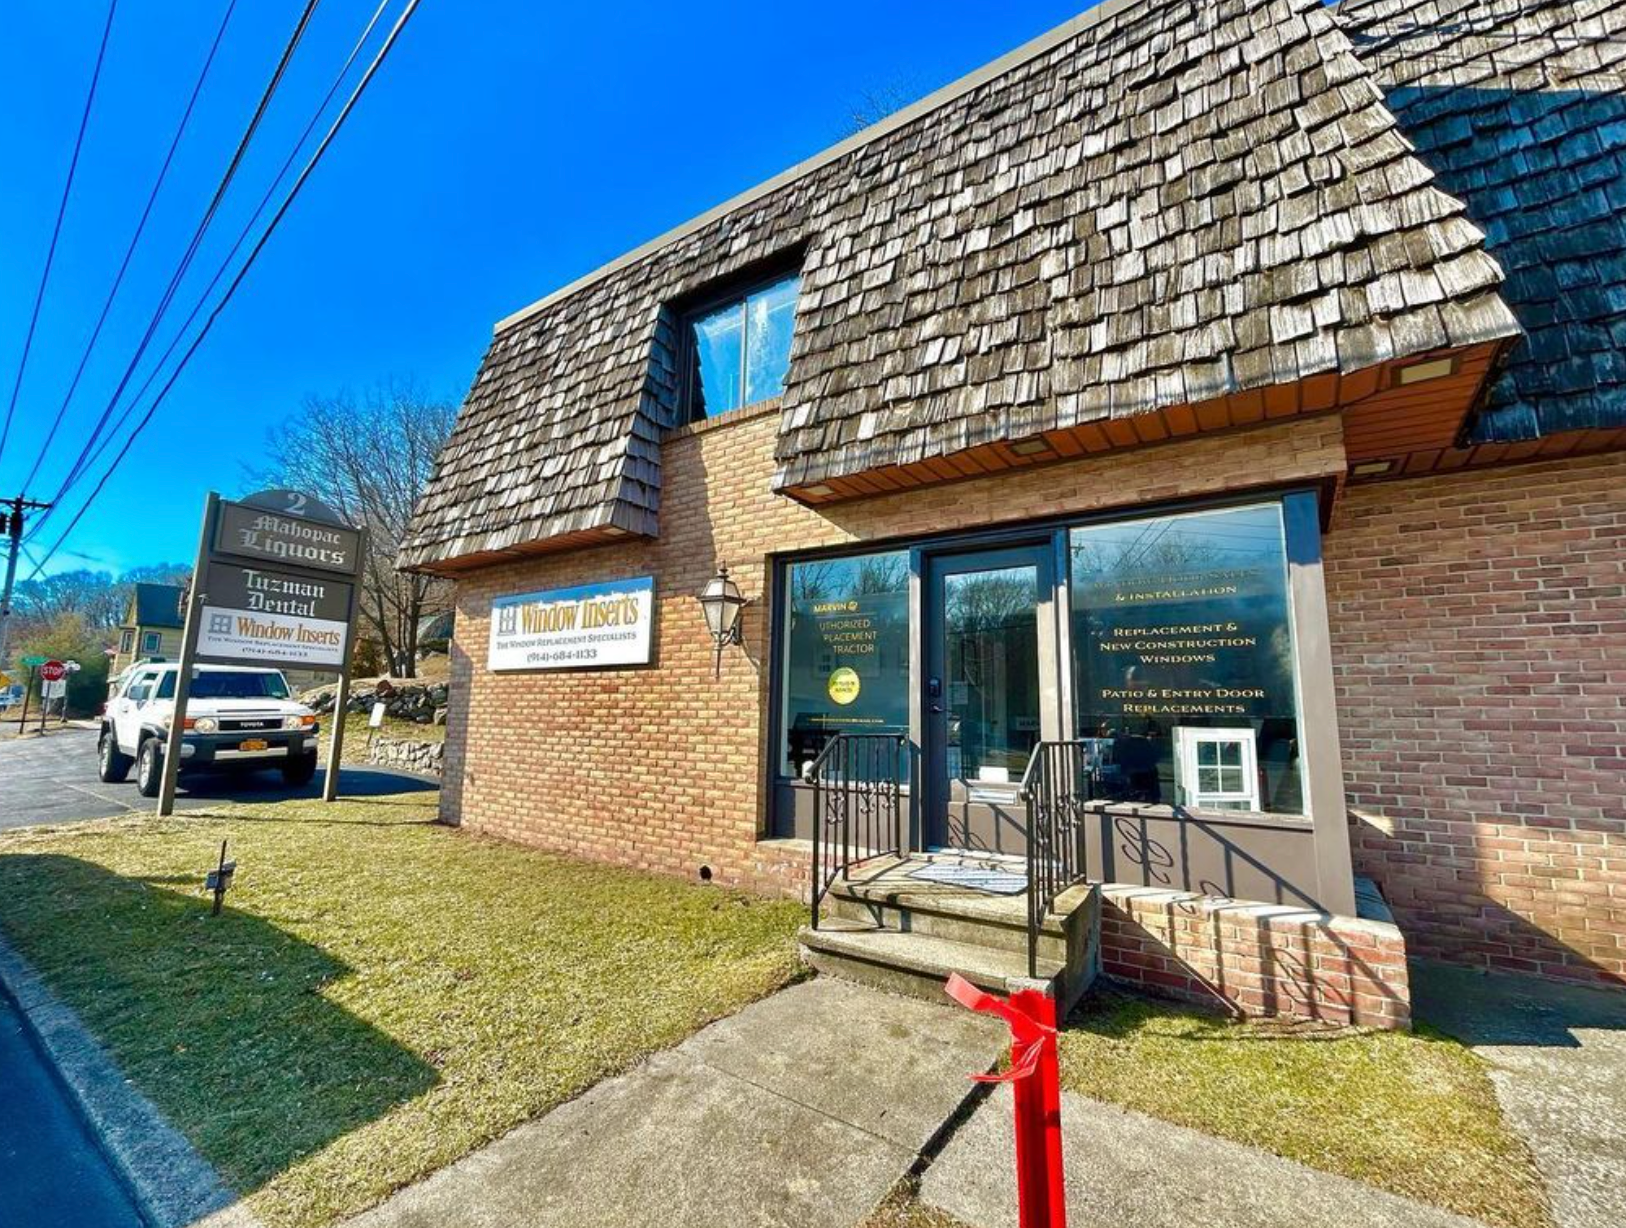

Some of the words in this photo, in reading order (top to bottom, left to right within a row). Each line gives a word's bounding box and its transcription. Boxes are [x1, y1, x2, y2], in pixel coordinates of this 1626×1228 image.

[284, 492, 307, 515] 2
[252, 515, 341, 545] Mahopac
[238, 528, 346, 566] Liquors
[242, 569, 325, 599] Tuzman
[1115, 593, 1125, 601] &
[1129, 585, 1237, 600] INSTALLATION
[247, 591, 316, 617] Dental
[521, 600, 579, 634] Window
[580, 595, 639, 629] Inserts
[236, 616, 294, 640] Window
[296, 623, 341, 646] Inserts
[1113, 623, 1222, 637] REPLACEMENT
[1223, 622, 1238, 632] &
[1100, 642, 1133, 652] NEW
[1134, 637, 1257, 650] CONSTRUCTION
[1140, 653, 1216, 664] WINDOWS
[43, 666, 64, 675] STOP
[1102, 689, 1144, 699] PATIO
[1147, 689, 1158, 699] &
[1162, 689, 1212, 699] ENTRY
[1216, 688, 1265, 699] DOOR
[1123, 703, 1246, 714] REPLACEMENTS
